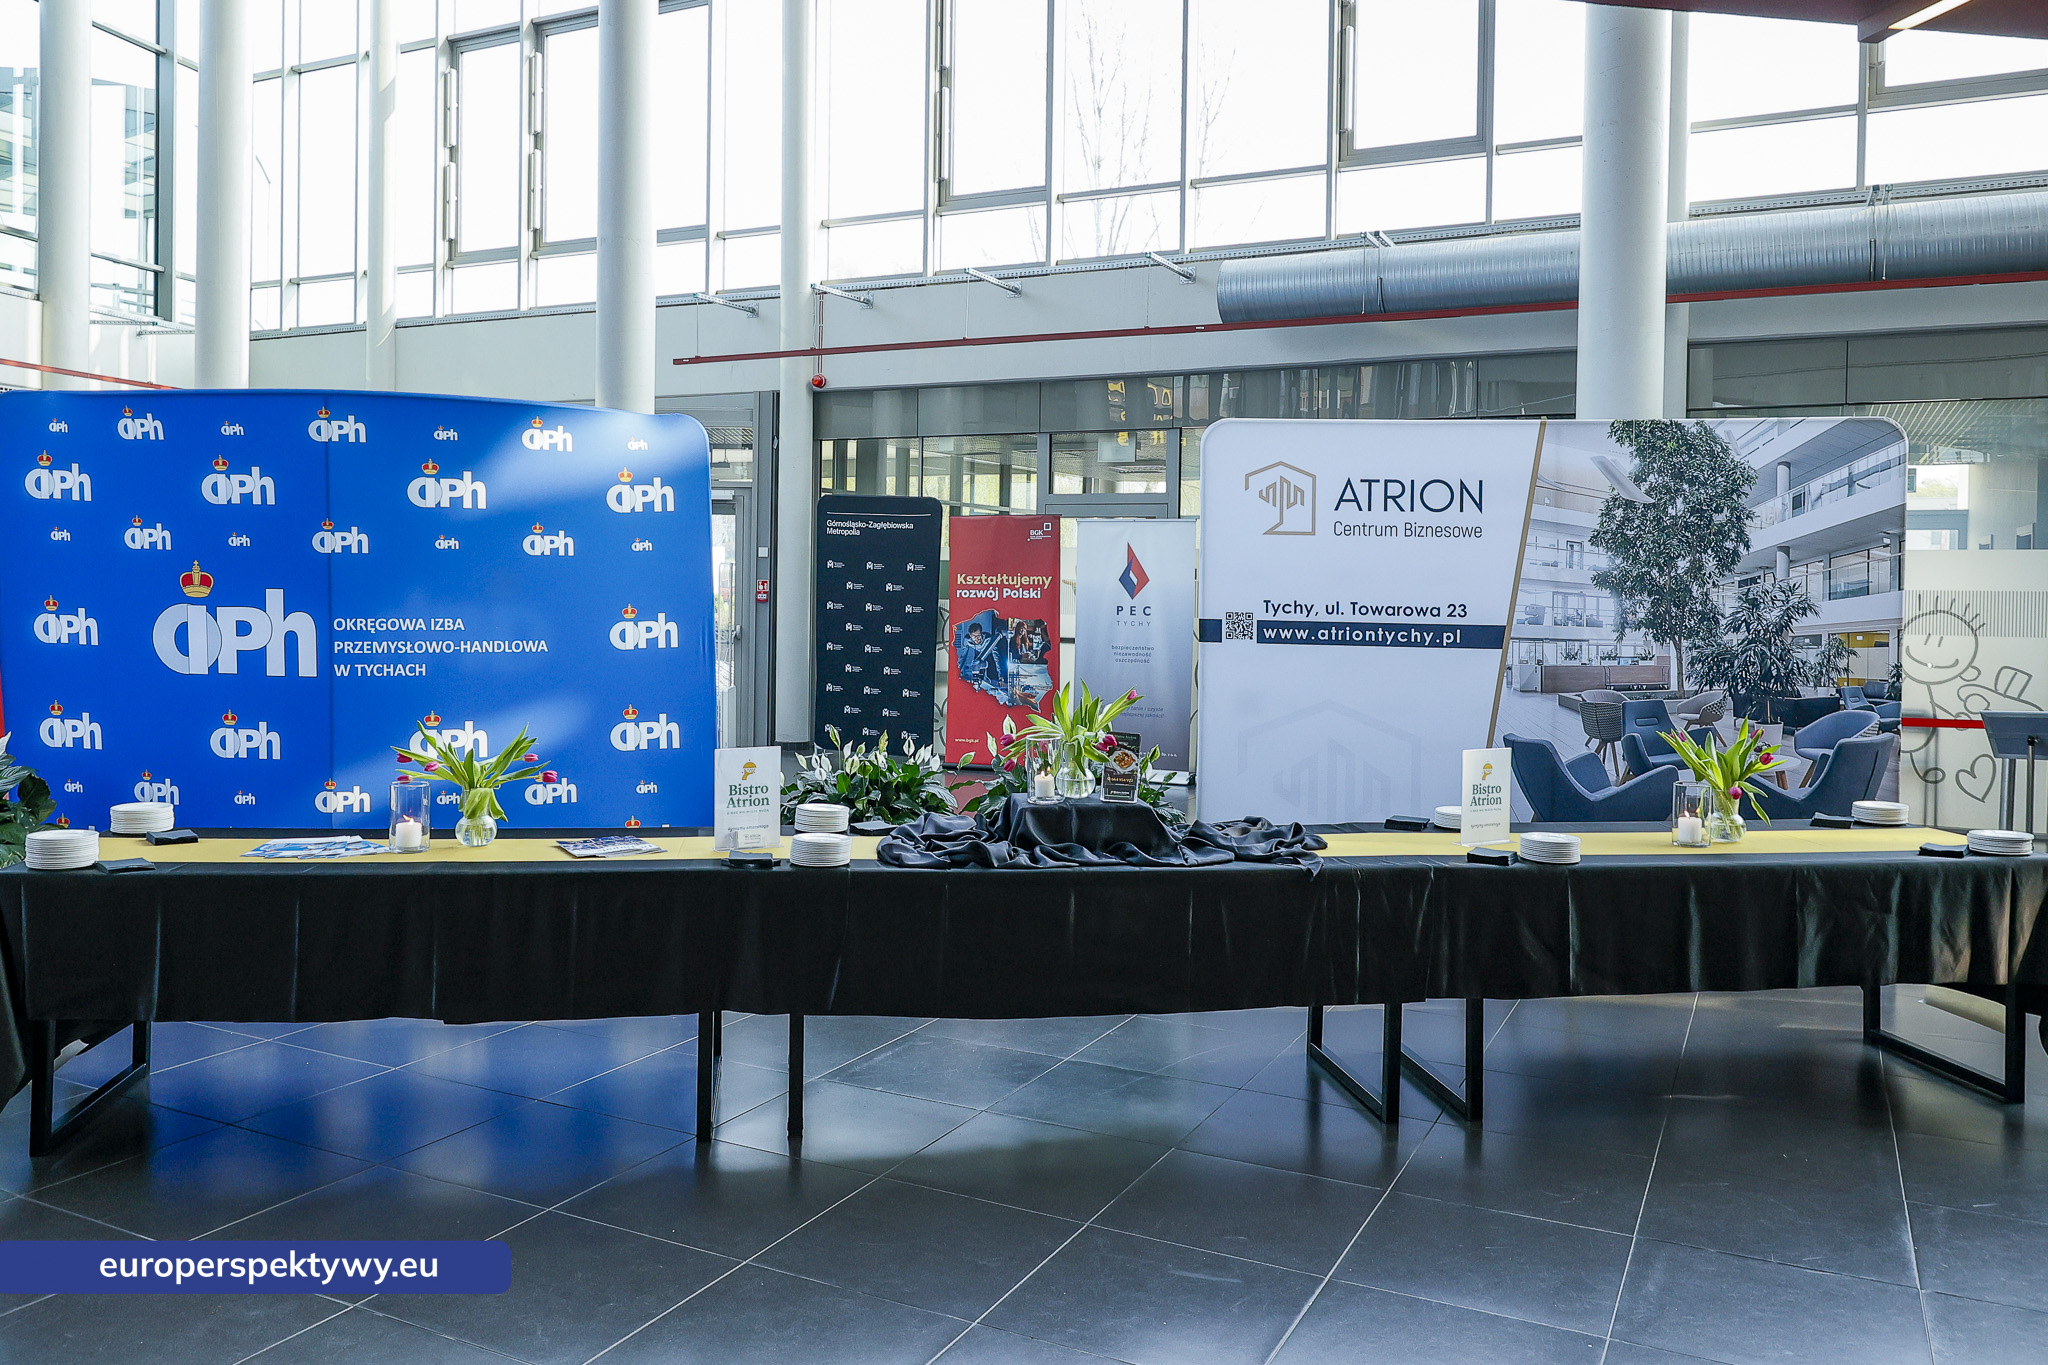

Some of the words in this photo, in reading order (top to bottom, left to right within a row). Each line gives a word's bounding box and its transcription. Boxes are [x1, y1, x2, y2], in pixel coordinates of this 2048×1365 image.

[1333, 477, 1483, 515] ATRION
[826, 527, 861, 537] Metropolia
[1333, 521, 1398, 537] Centrum
[1404, 522, 1483, 538] Biznesowe
[957, 572, 1053, 590] Kształtujemy
[956, 586, 999, 602] rozwój
[1003, 587, 1041, 599] Polski
[1116, 605, 1152, 617] PEC
[1263, 600, 1319, 618] Tychy,
[1326, 601, 1345, 616] ul.
[1350, 602, 1441, 618] Towarowa
[1447, 603, 1468, 618] 23
[333, 618, 427, 634] OKRĘGOWA
[430, 618, 466, 631] IZBA
[1116, 620, 1151, 628] TYCHY
[1263, 626, 1462, 645] www.atriontychy.pl
[334, 639, 549, 654] PRZEMYSŁOWO-HANDLOWA
[333, 663, 351, 677] W
[355, 663, 427, 677] TYCHACH
[728, 783, 769, 797] Bistro
[1472, 783, 1502, 796] Bistro
[726, 795, 770, 809] Atrion
[1469, 794, 1503, 807] Atrion
